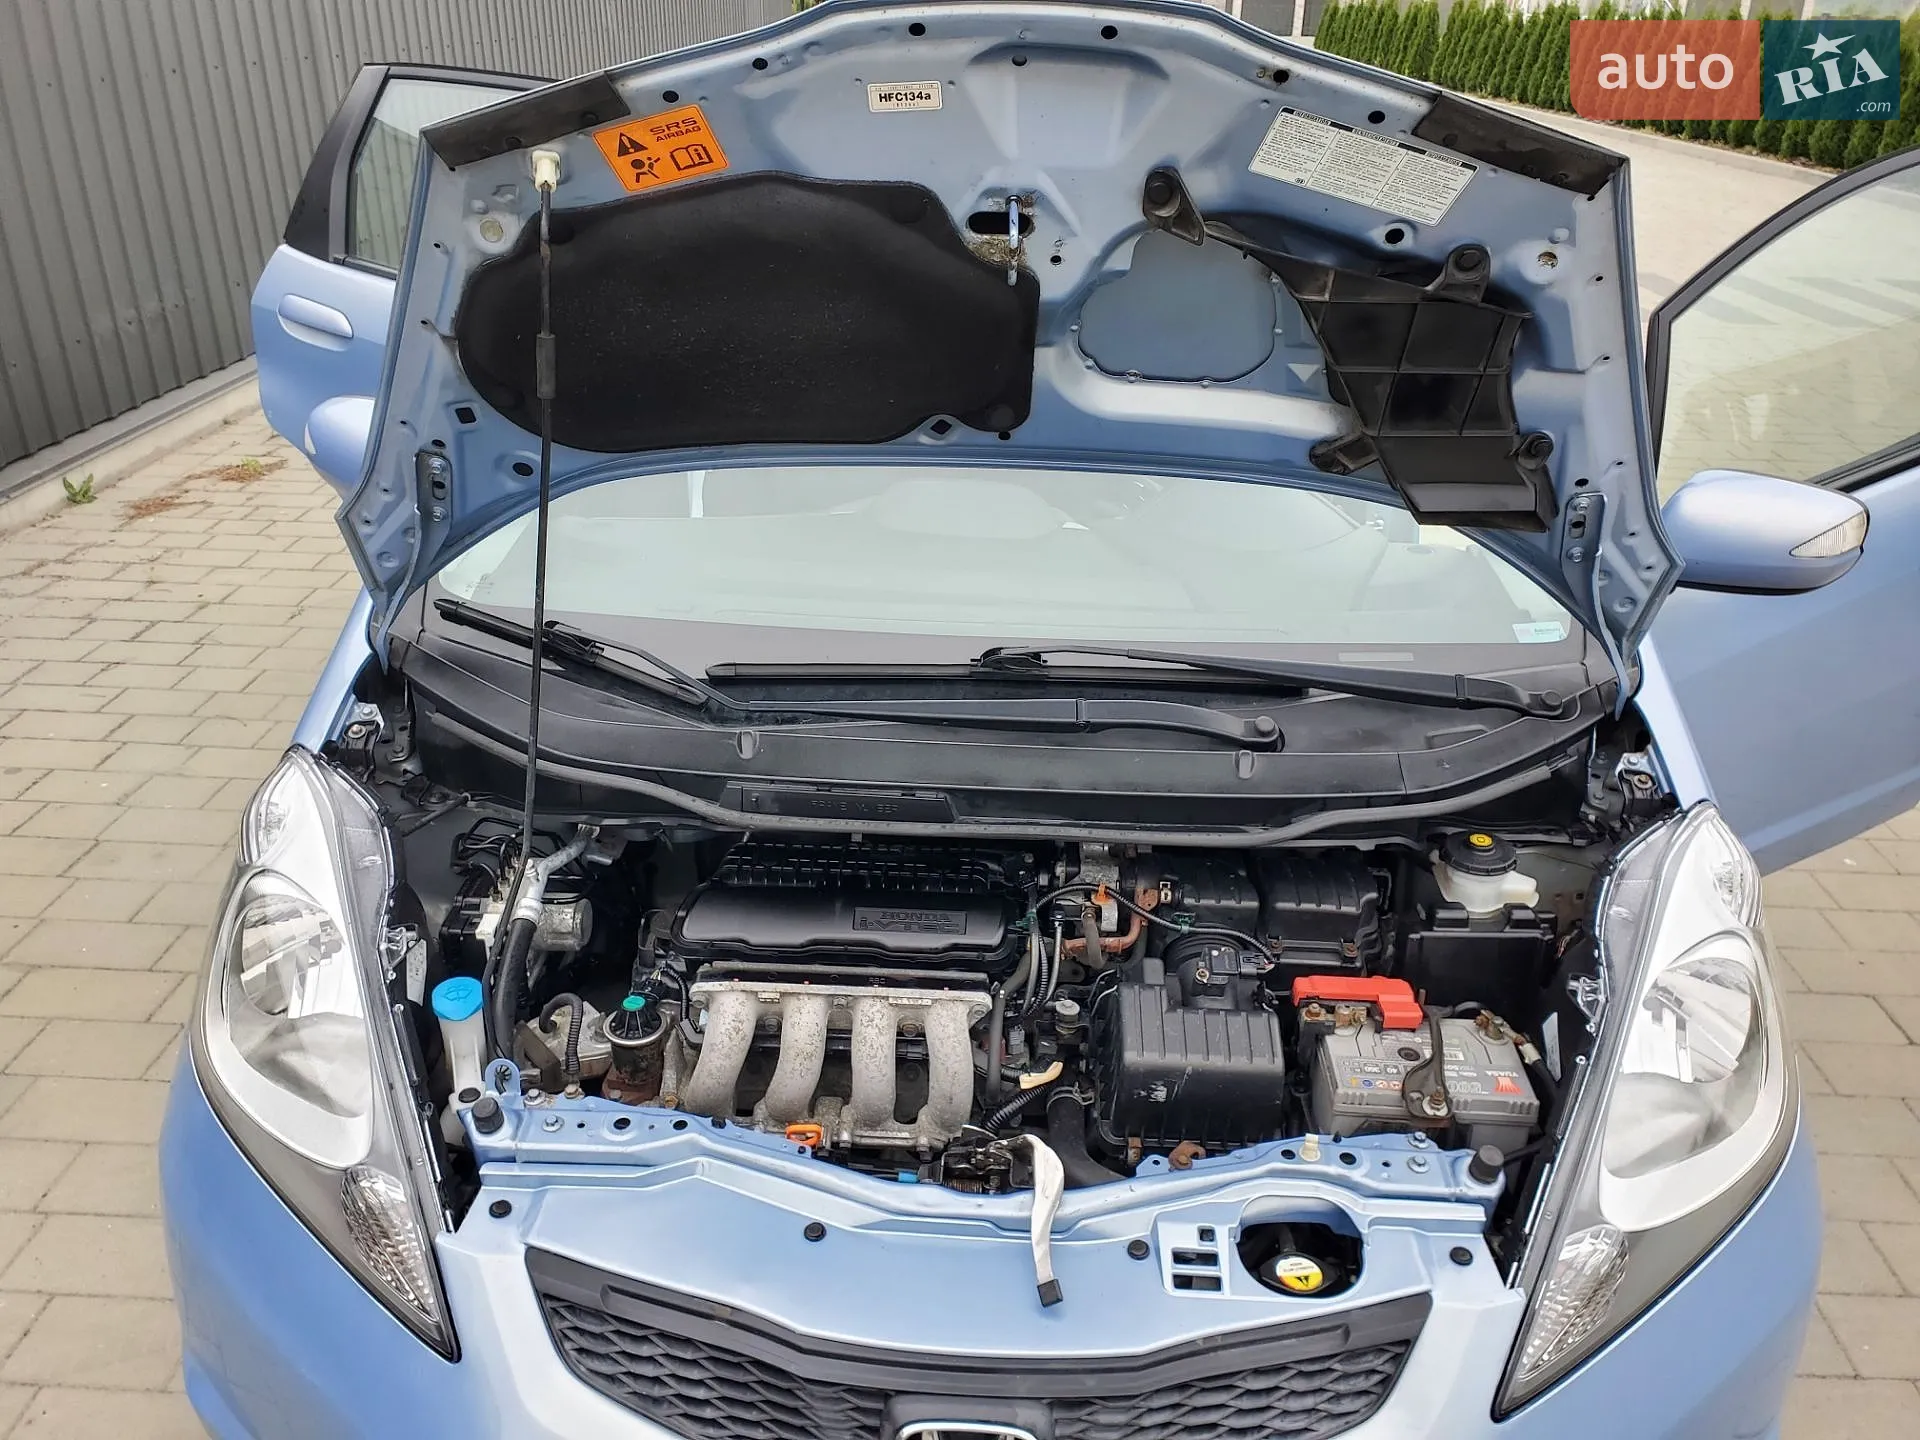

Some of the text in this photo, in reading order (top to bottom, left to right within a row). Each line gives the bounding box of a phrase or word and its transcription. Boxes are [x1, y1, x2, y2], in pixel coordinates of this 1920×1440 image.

[878, 91, 931, 103] HFC134a
[649, 117, 698, 136] SRS
[655, 126, 702, 143] AIRBAG
[880, 911, 952, 923] HONDA
[1485, 1070, 1520, 1078] YUASA
